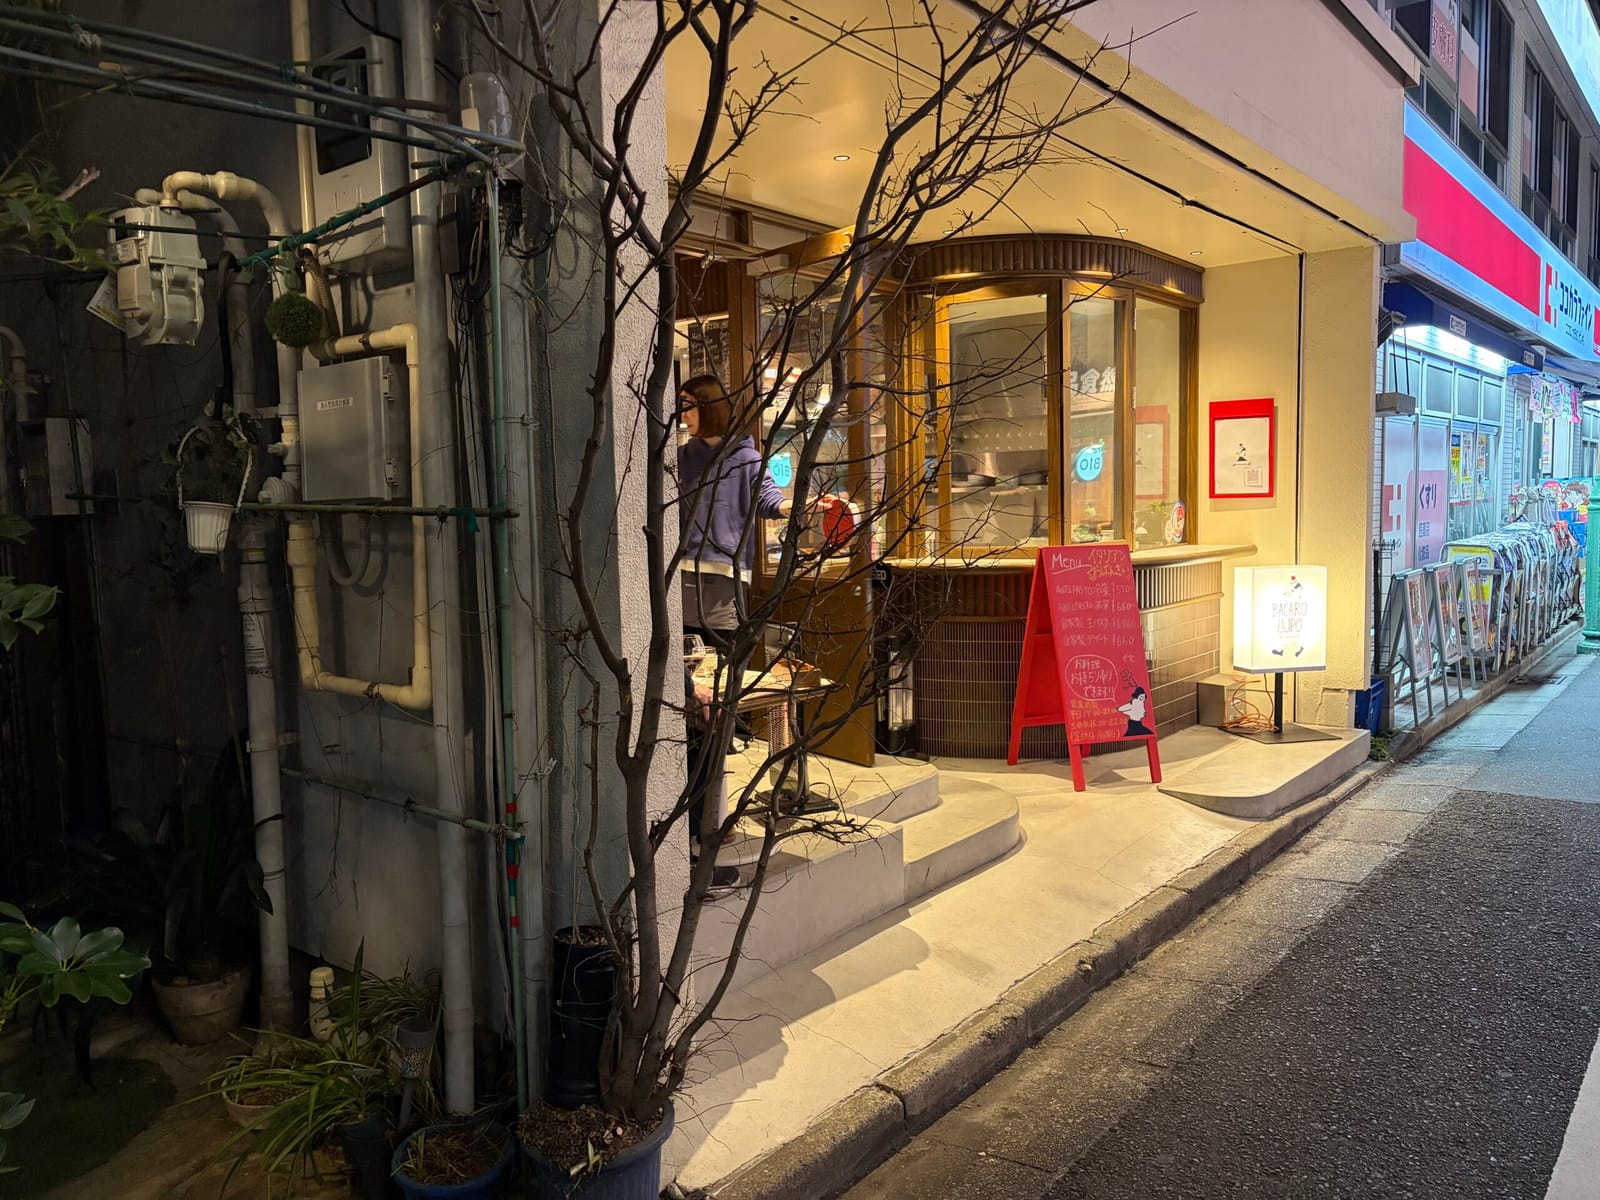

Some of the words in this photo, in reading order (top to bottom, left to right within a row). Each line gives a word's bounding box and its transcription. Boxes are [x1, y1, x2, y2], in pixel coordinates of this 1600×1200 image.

[1559, 281, 1593, 332] ココカラファイン
[1419, 482, 1437, 509] くすり
[1051, 552, 1082, 569] Menu
[1087, 549, 1126, 564] イタリアン
[1073, 658, 1101, 670] お料理
[1071, 669, 1112, 686] お持ち帰り
